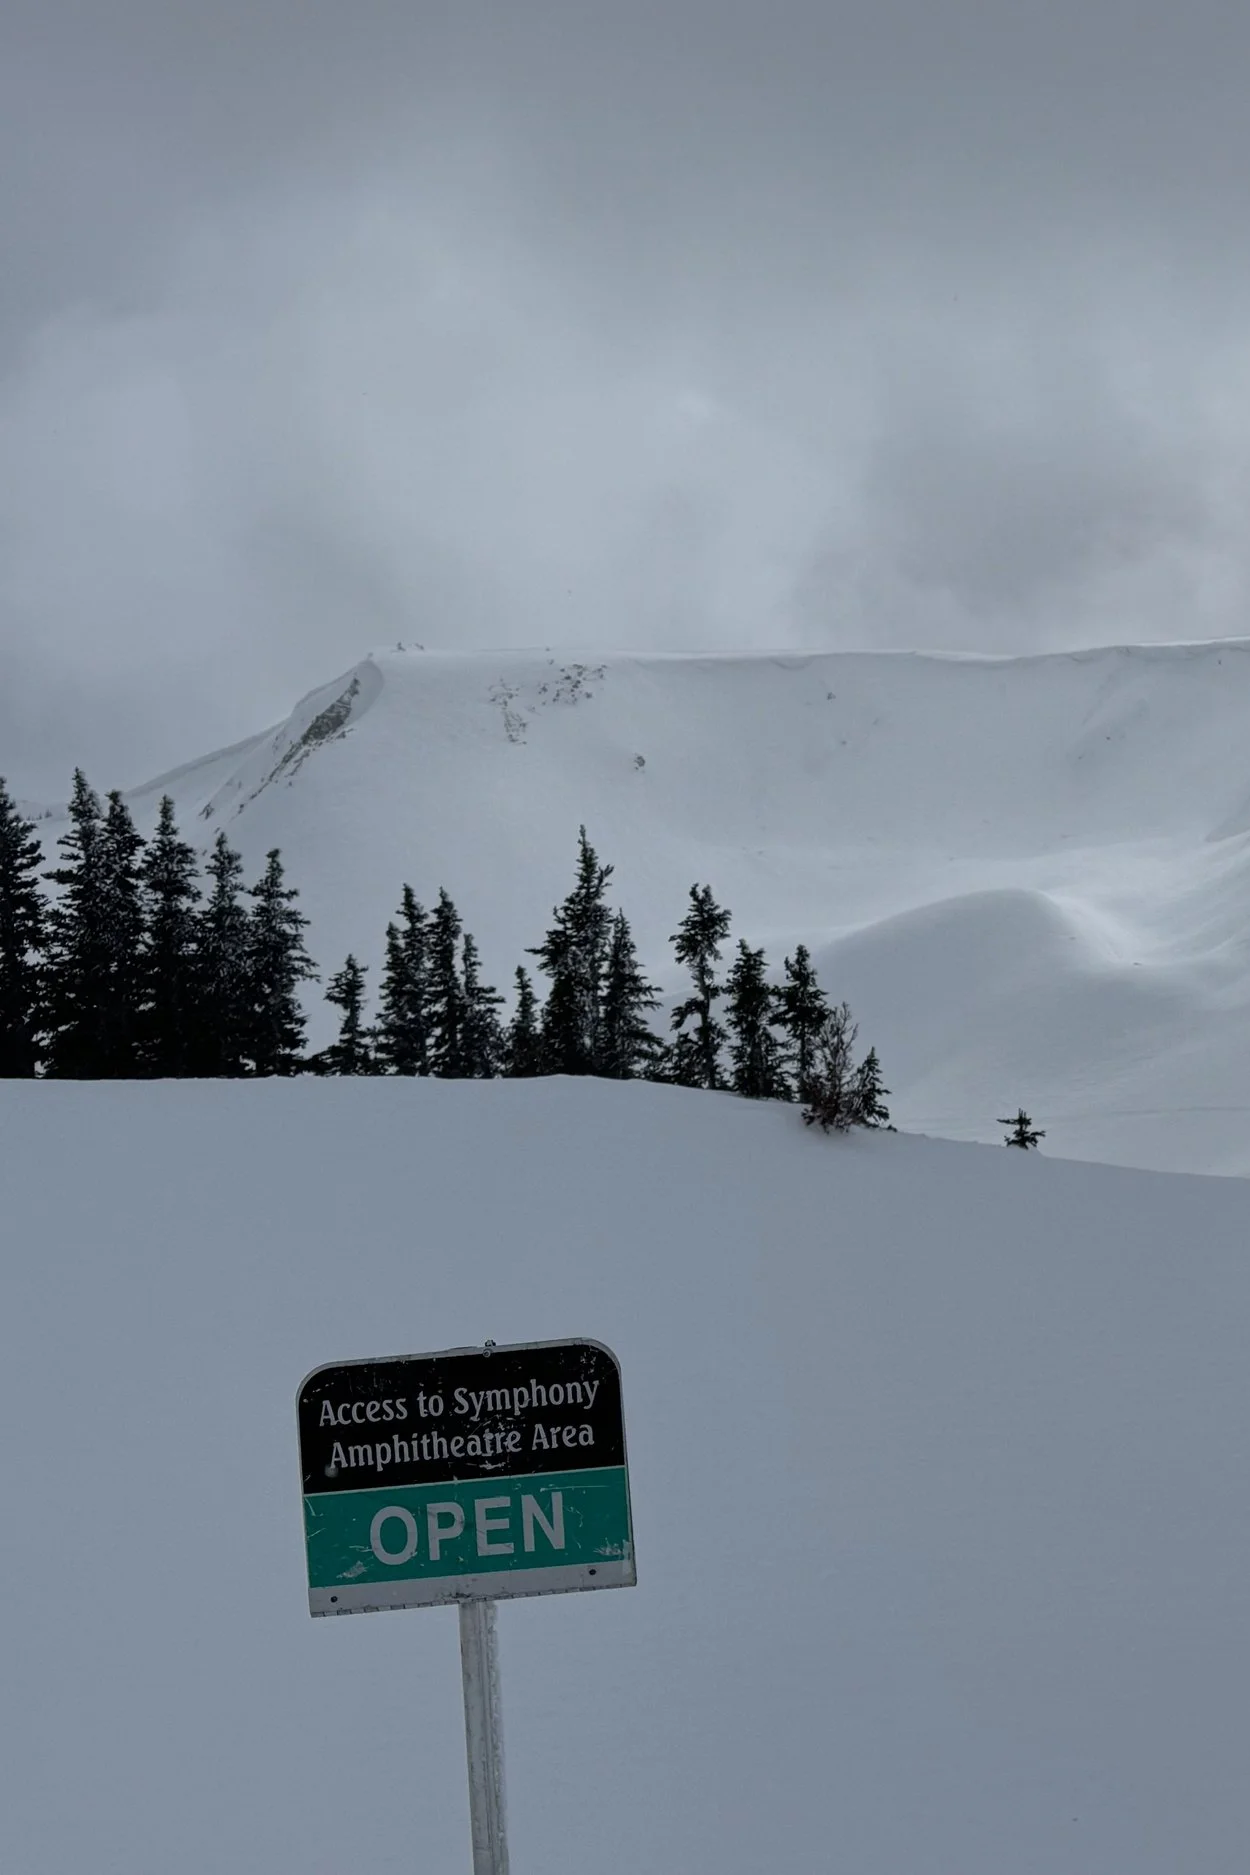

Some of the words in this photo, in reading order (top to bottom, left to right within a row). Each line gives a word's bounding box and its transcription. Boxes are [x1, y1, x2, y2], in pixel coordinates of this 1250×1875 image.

[319, 1397, 409, 1427] Access
[417, 1391, 445, 1419] to
[453, 1379, 600, 1422] Symphony
[329, 1430, 522, 1471] Amphitheatre
[531, 1423, 595, 1451] Area
[369, 1491, 566, 1566] OPEN
